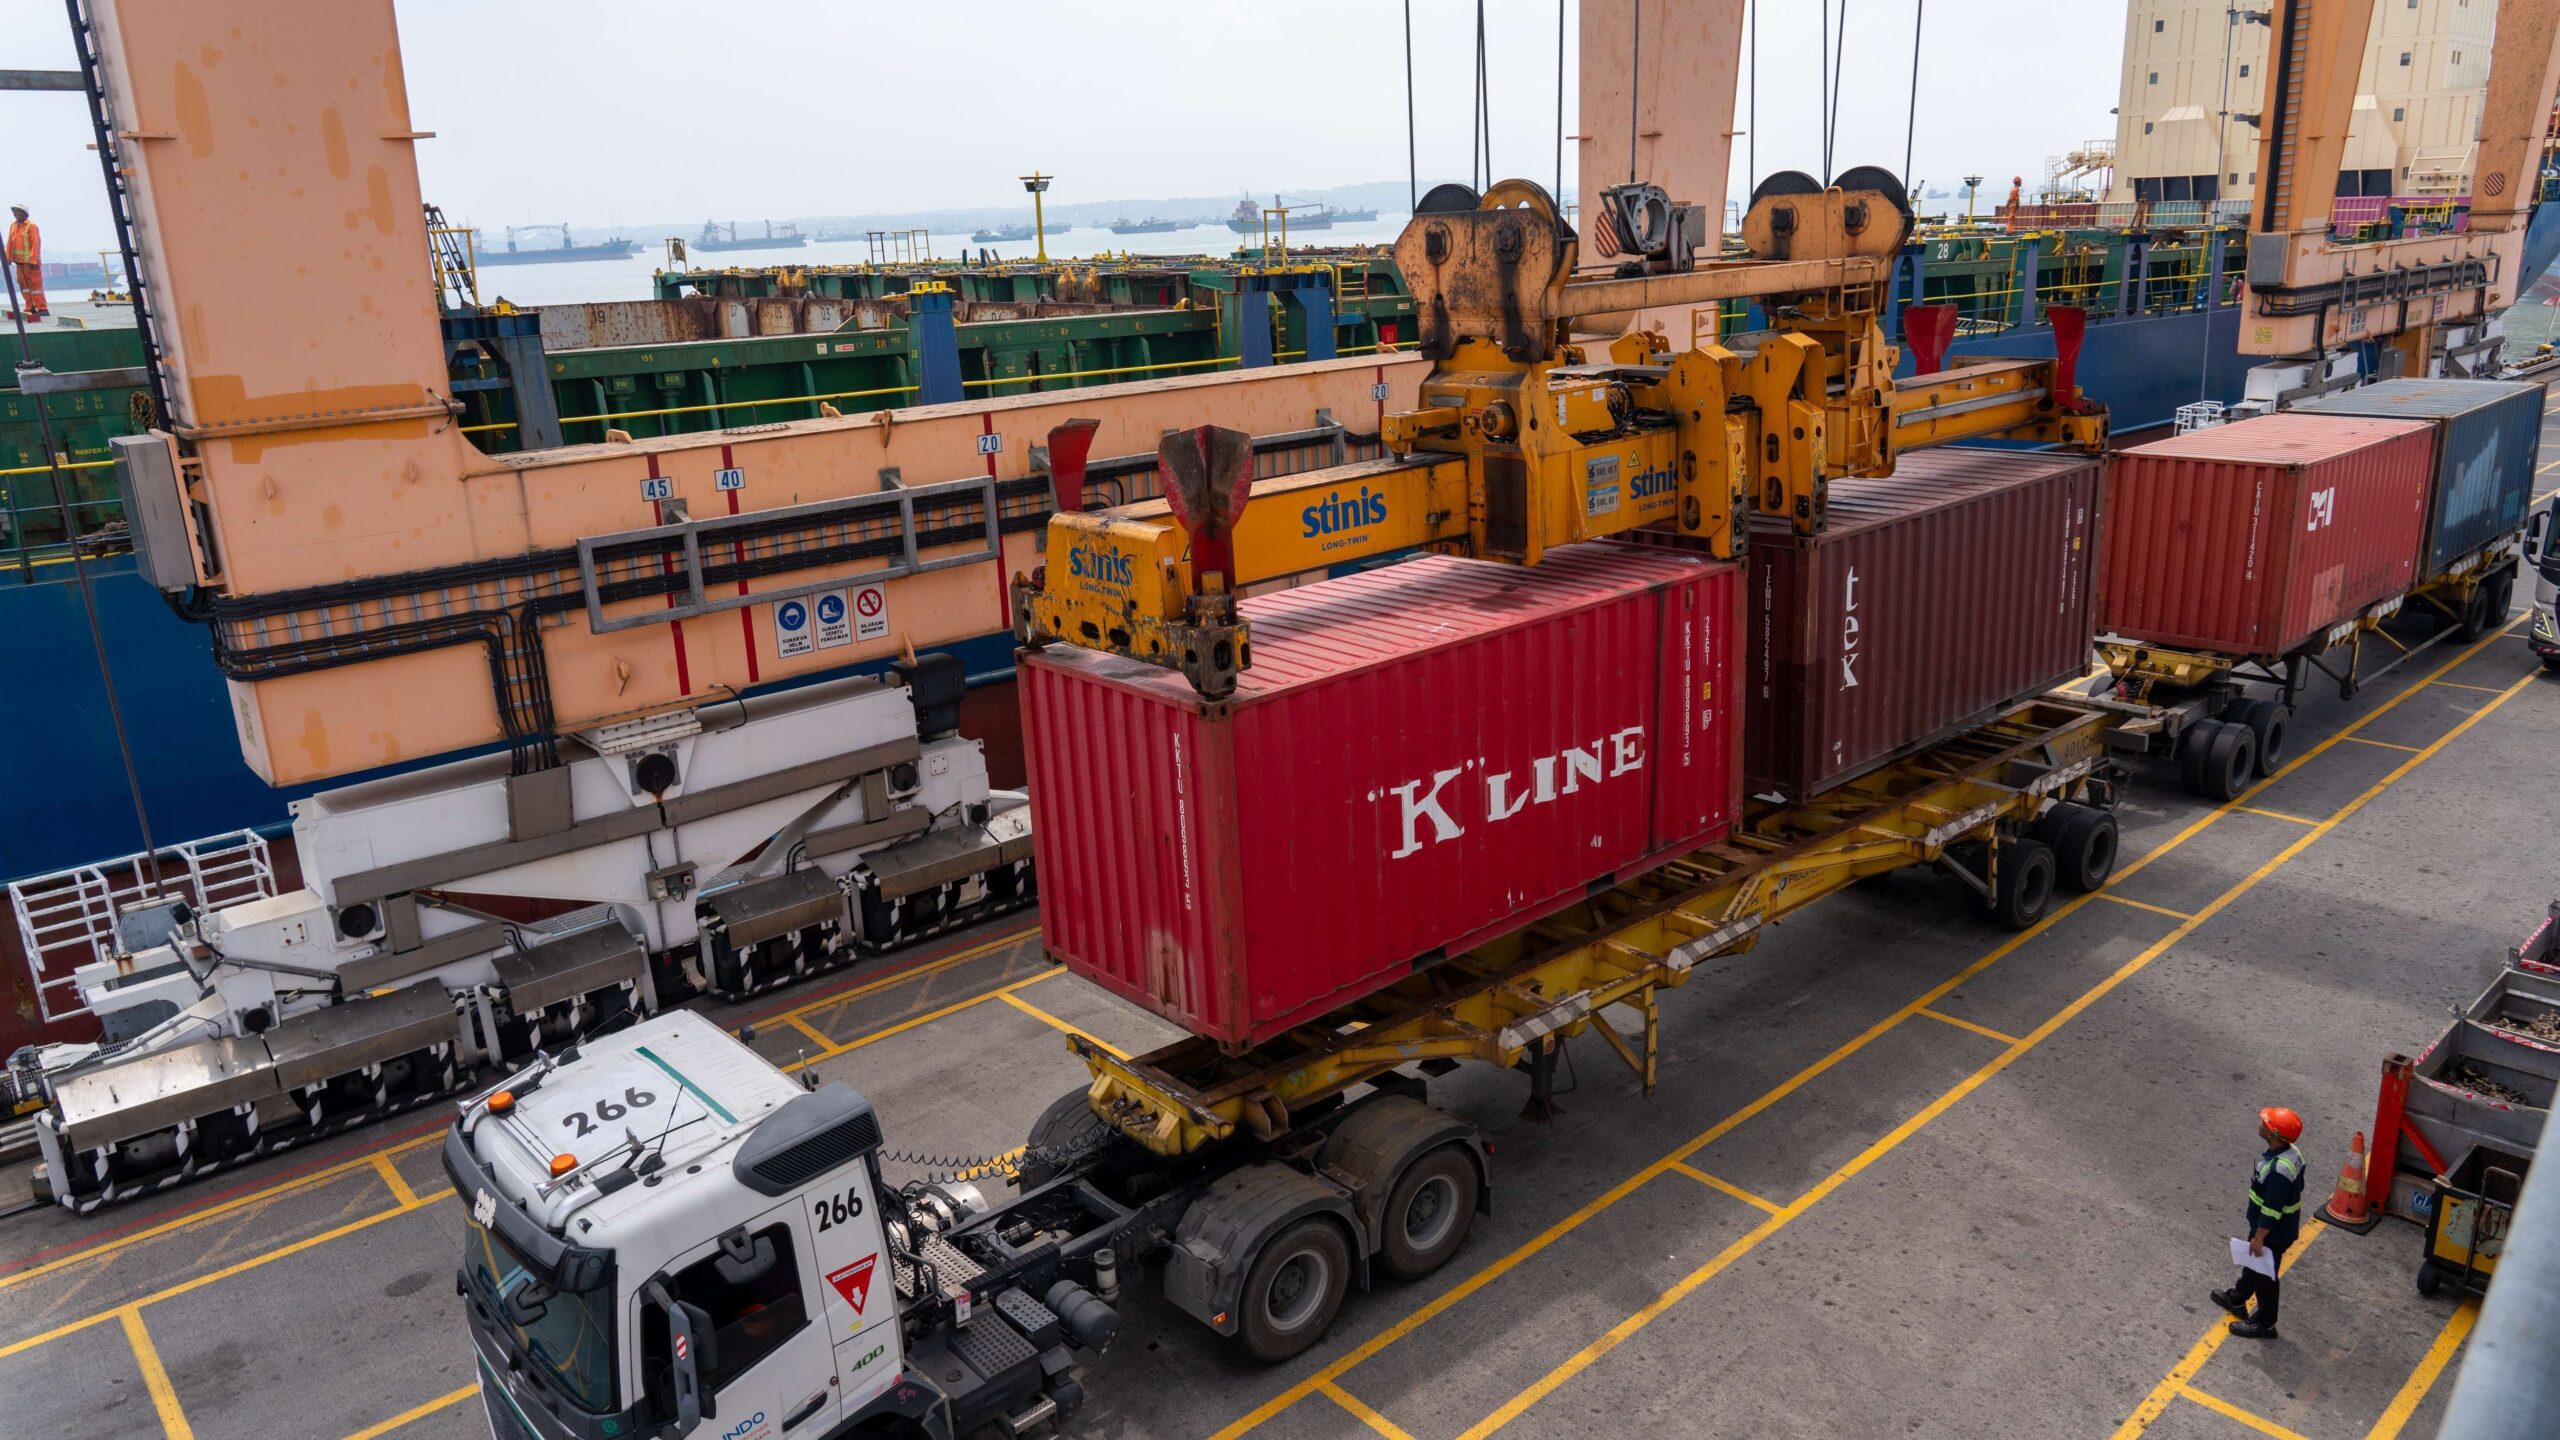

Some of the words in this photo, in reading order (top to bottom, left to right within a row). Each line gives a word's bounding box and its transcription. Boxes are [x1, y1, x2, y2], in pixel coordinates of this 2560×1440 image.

[1937, 242, 1949, 260] 28
[1374, 384, 1387, 399] 20
[981, 435, 998, 453] 20
[720, 470, 740, 488] 40
[647, 480, 668, 498] 45
[1302, 485, 1387, 538] stinis
[1321, 534, 1368, 551] LONG-TWIN
[821, 623, 846, 632] GUNAKAN
[1839, 565, 1859, 692] tex
[782, 635, 808, 644] GUNAKAN
[820, 633, 849, 642] PENGAMAN
[782, 645, 811, 654] PENGAMAN
[1173, 732, 1183, 794] KKTU
[1487, 725, 1646, 823] LINE
[562, 1086, 656, 1139] 266
[814, 1186, 863, 1233] 266
[851, 1344, 885, 1373] 400
